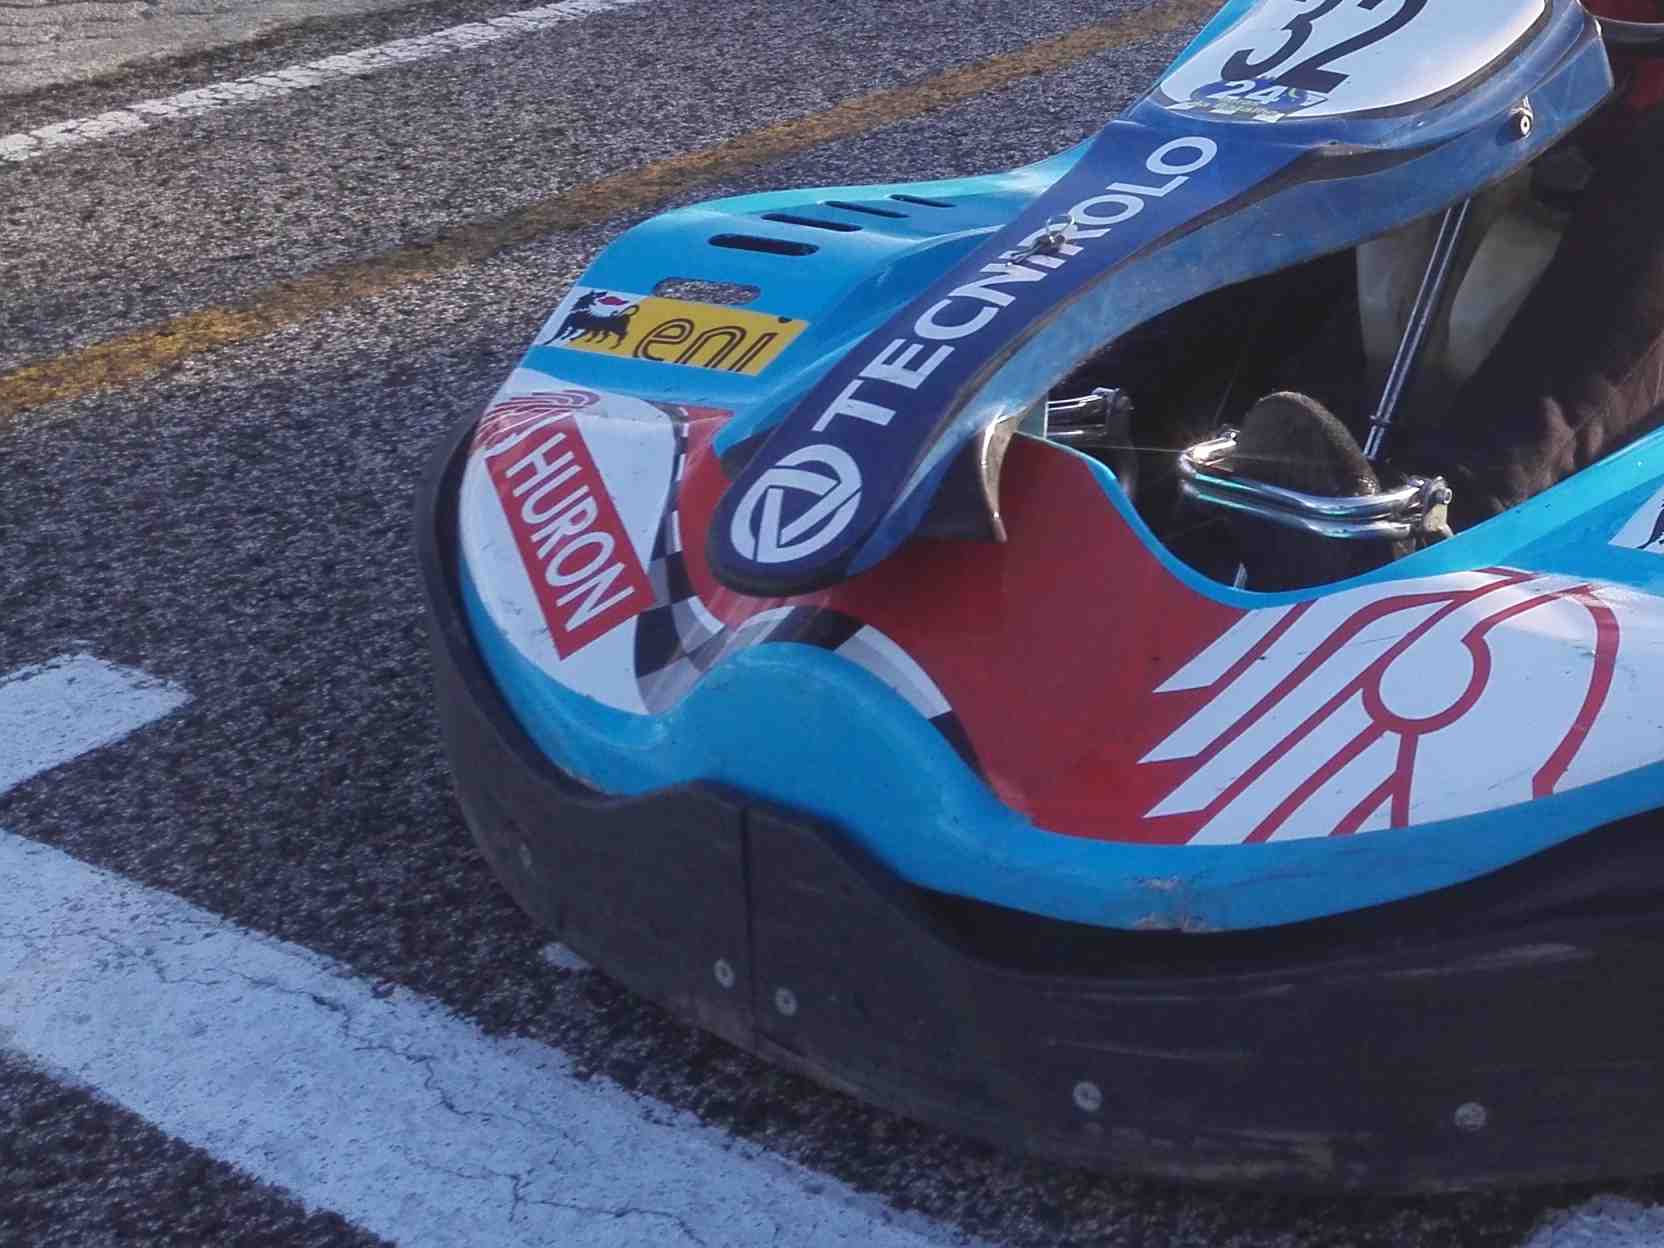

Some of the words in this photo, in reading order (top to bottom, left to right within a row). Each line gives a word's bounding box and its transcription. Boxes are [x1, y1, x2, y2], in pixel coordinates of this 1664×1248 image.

[633, 312, 793, 373] eni
[813, 135, 1218, 428] TECNIROLO
[505, 432, 634, 633] HURON
